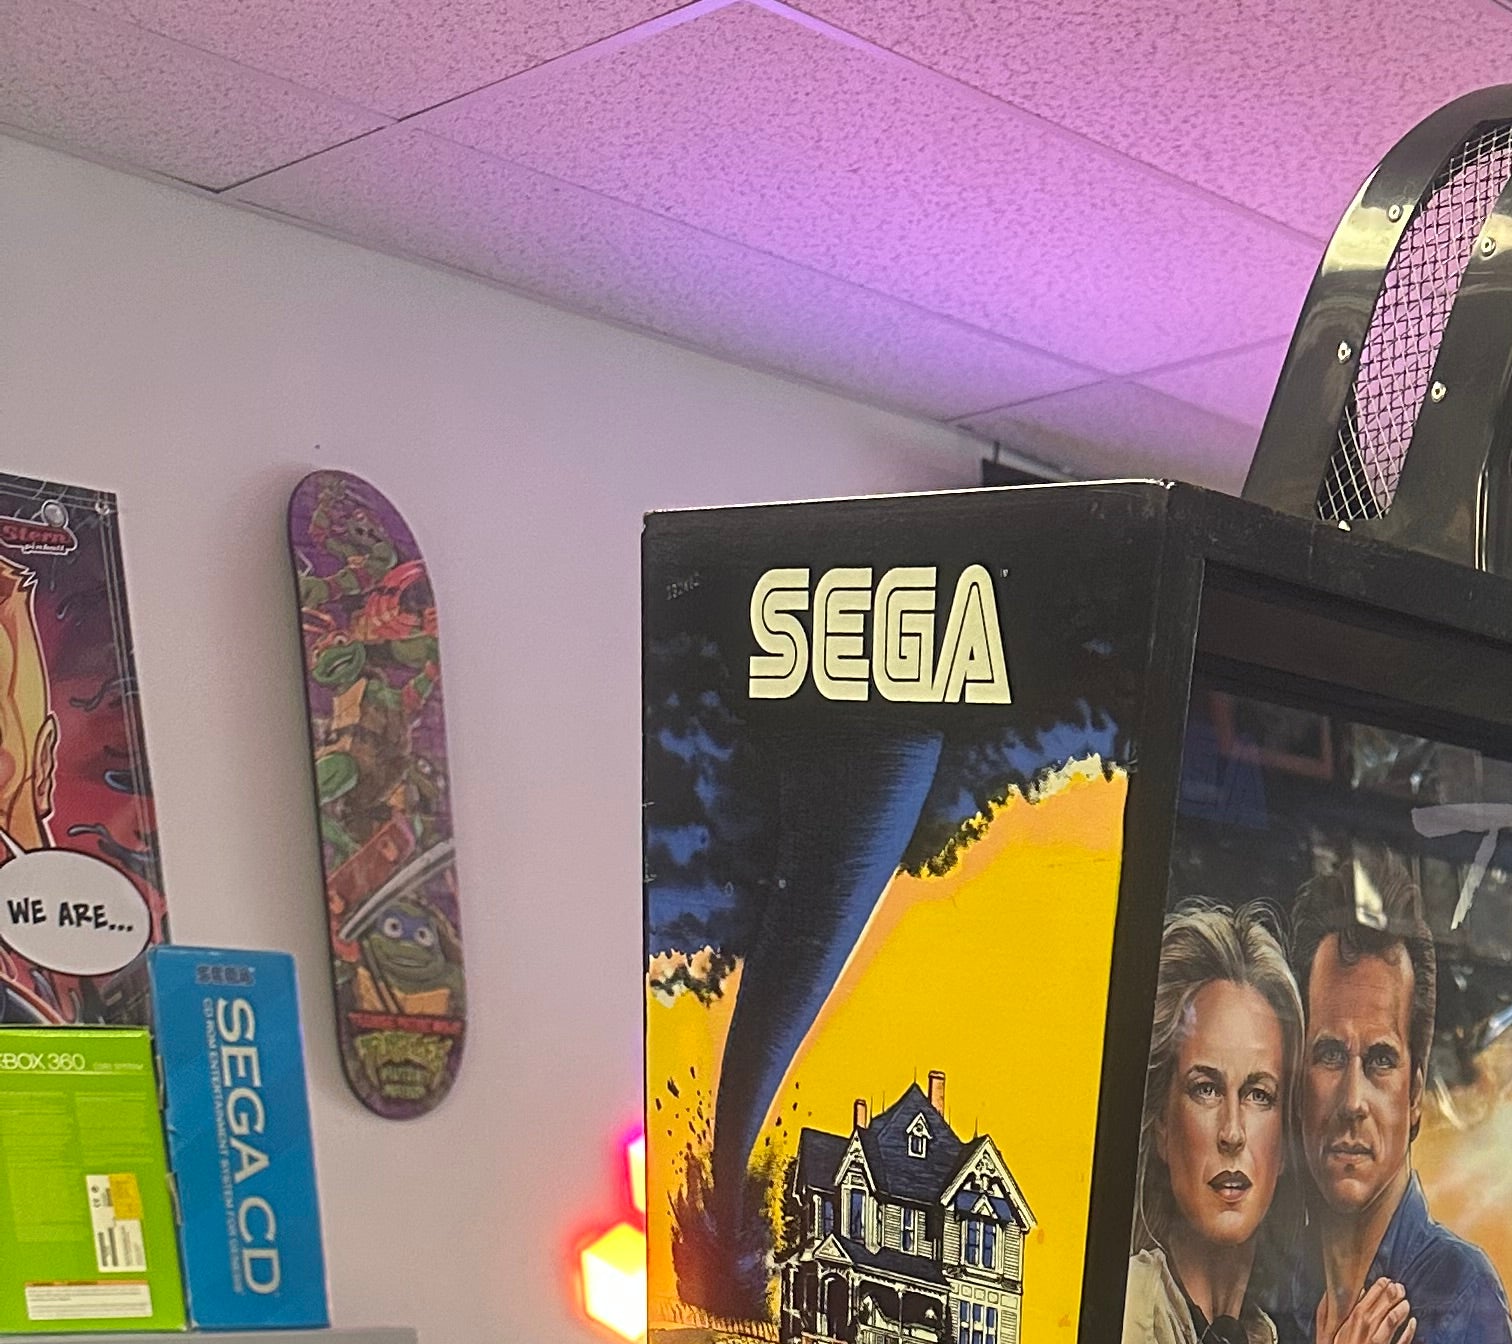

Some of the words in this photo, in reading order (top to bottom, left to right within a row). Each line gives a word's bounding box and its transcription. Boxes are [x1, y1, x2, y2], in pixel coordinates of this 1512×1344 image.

[749, 564, 1011, 704] SEGA
[7, 897, 46, 924] WE
[59, 901, 134, 932] ARE...
[47, 1053, 86, 1071] 360
[216, 998, 270, 1184] SEGA
[238, 1197, 281, 1295] CD
